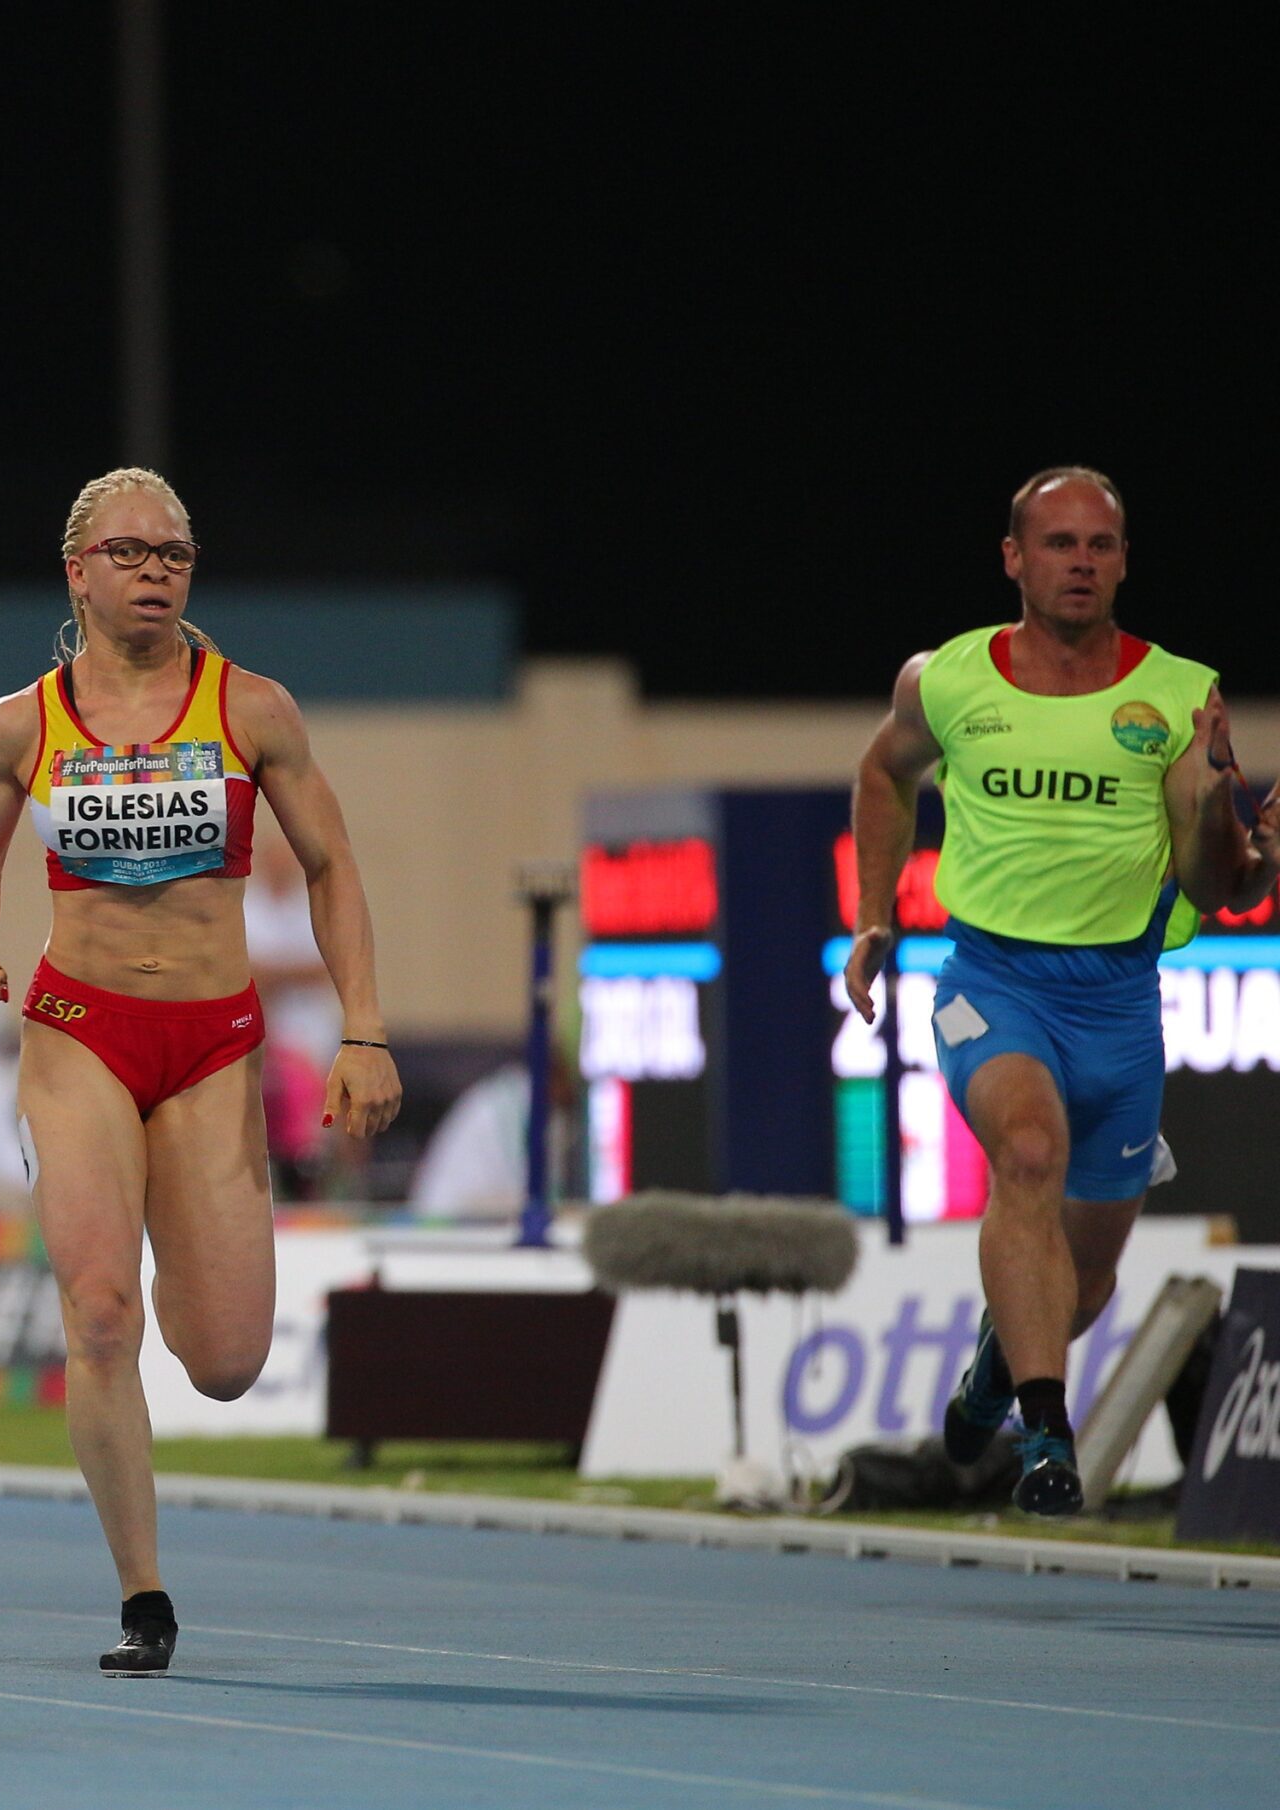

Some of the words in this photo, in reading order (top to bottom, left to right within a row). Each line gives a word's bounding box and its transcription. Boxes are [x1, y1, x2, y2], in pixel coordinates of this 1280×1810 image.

[62, 757, 170, 776] #ForPeopleForPlanet
[177, 761, 217, 772] GALS
[981, 767, 1121, 806] GUIDE
[68, 790, 209, 822] IGLESIAS
[58, 822, 220, 851] FORNEIRO
[112, 860, 141, 871] DUBAI
[34, 992, 88, 1023] ESP
